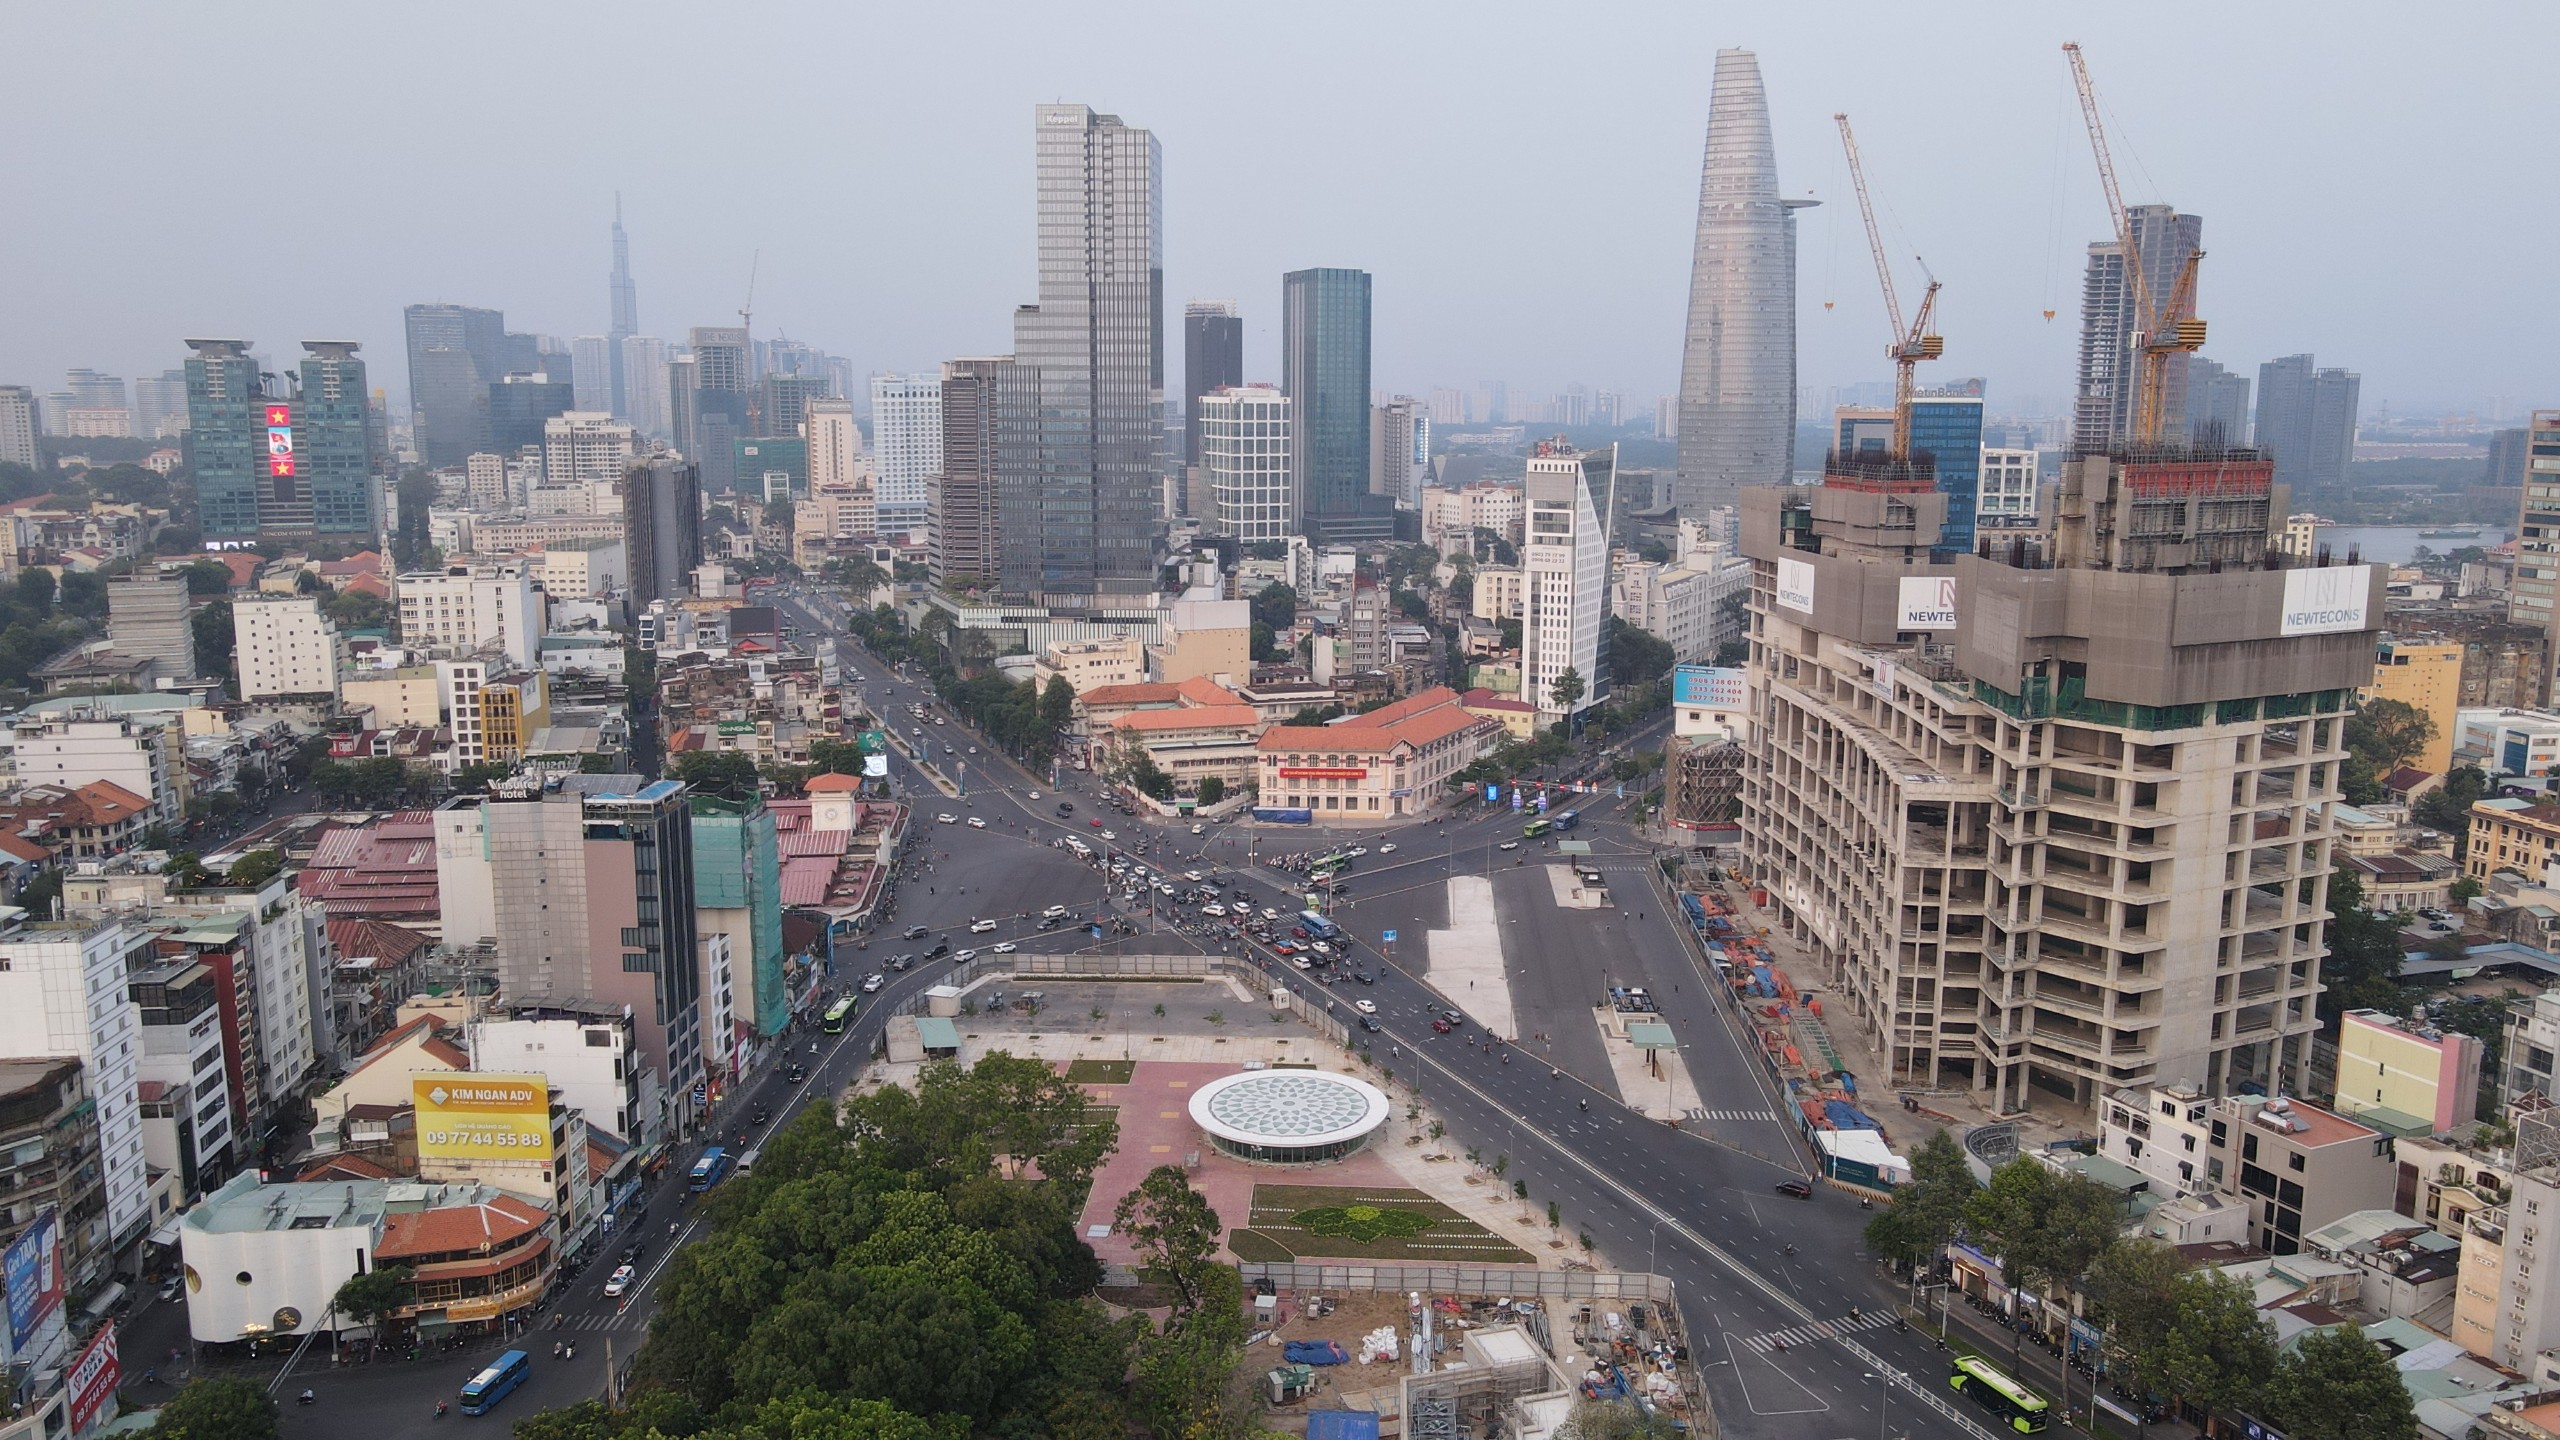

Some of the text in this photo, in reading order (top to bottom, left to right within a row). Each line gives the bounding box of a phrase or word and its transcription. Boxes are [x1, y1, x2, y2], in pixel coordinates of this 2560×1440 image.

[1046, 115, 1078, 124] Keppel
[704, 332, 741, 341] THE NEXUS
[1553, 445, 1573, 456] MB
[1780, 589, 1809, 606] NEWTECONS
[1908, 611, 1956, 622] NEWTE
[2287, 609, 2360, 626] NEWTECONS
[1727, 678, 1742, 686] 017
[1710, 695, 1725, 703] 755
[500, 789, 527, 799] hotel
[452, 1088, 533, 1101] KIM NGAN ADV
[426, 1131, 542, 1146] 09 77 44 55 88
[84, 1356, 103, 1384] NGAN
